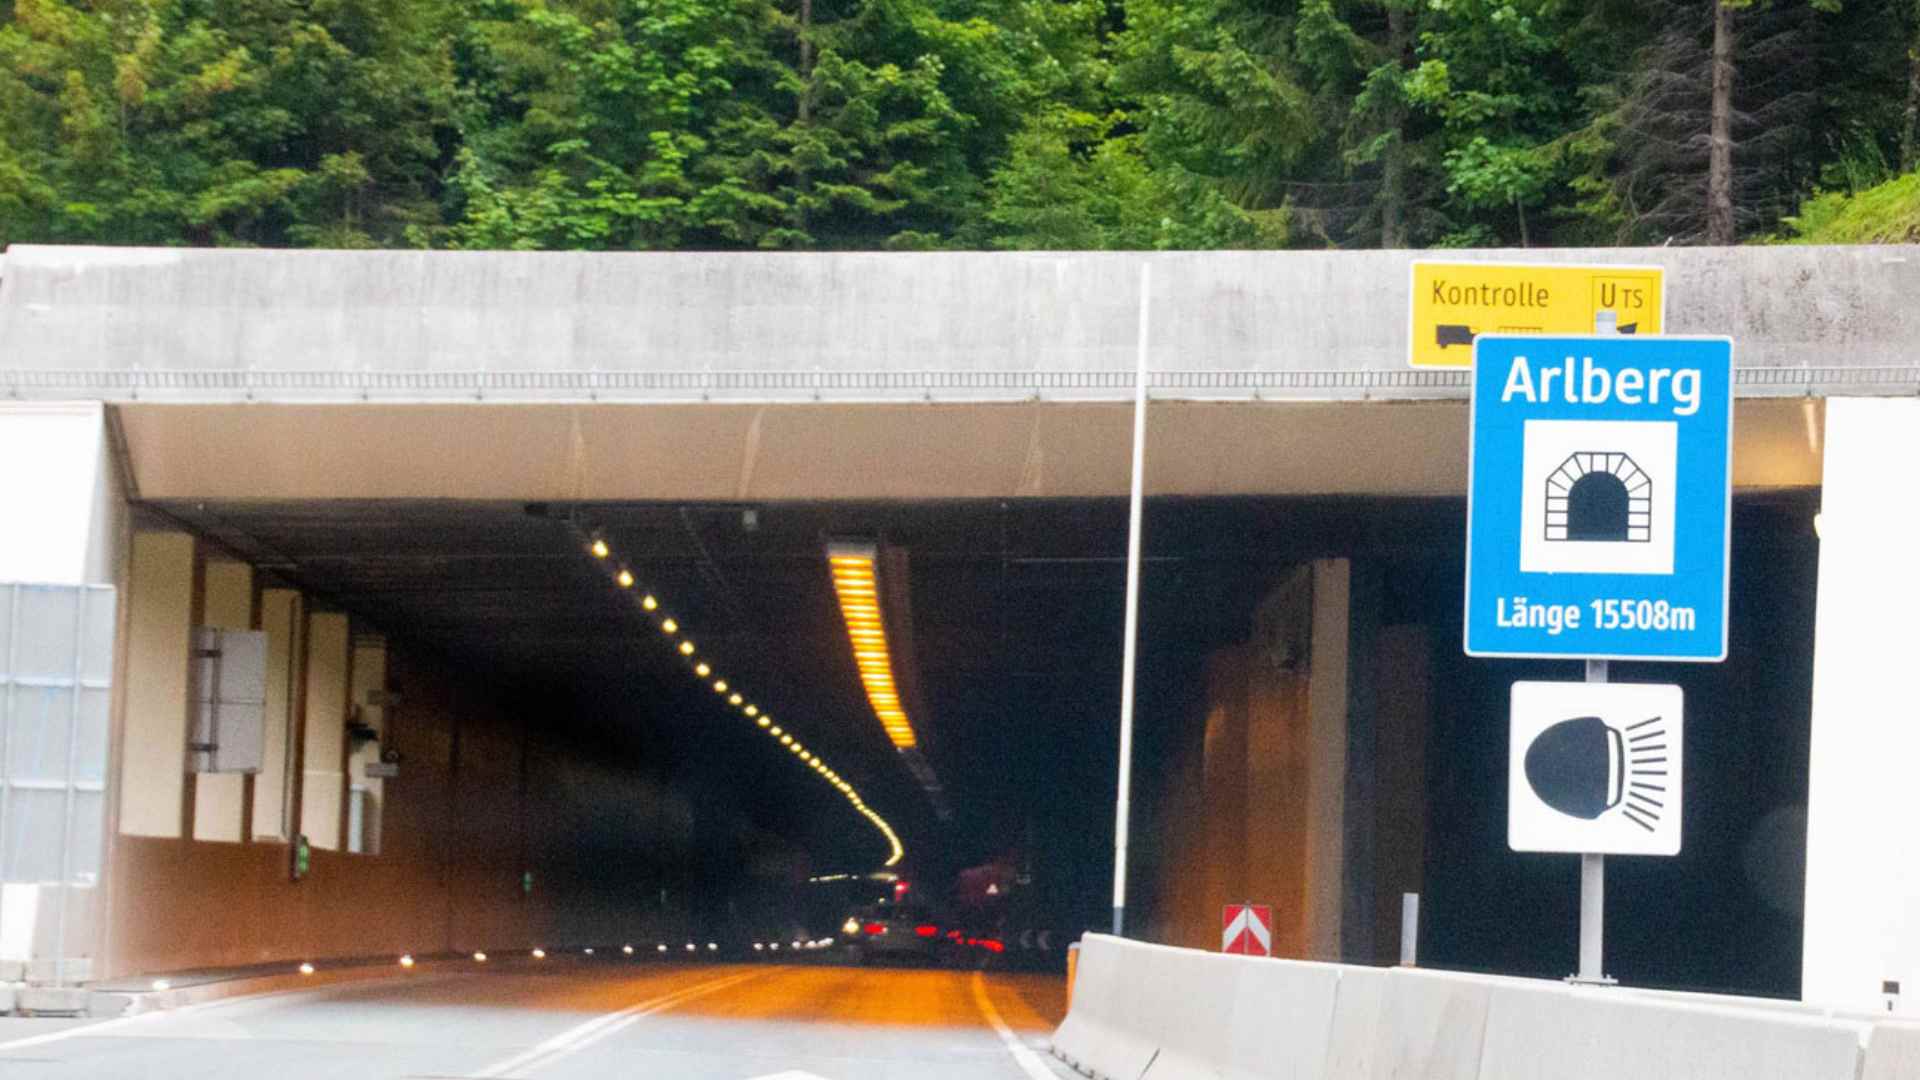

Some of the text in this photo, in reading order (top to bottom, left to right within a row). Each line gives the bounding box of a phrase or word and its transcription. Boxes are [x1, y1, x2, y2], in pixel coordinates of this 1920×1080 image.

[1432, 280, 1549, 308] Kontrolle
[1501, 355, 1702, 416] Arlberg
[1496, 597, 1696, 635] Länge 15508m
